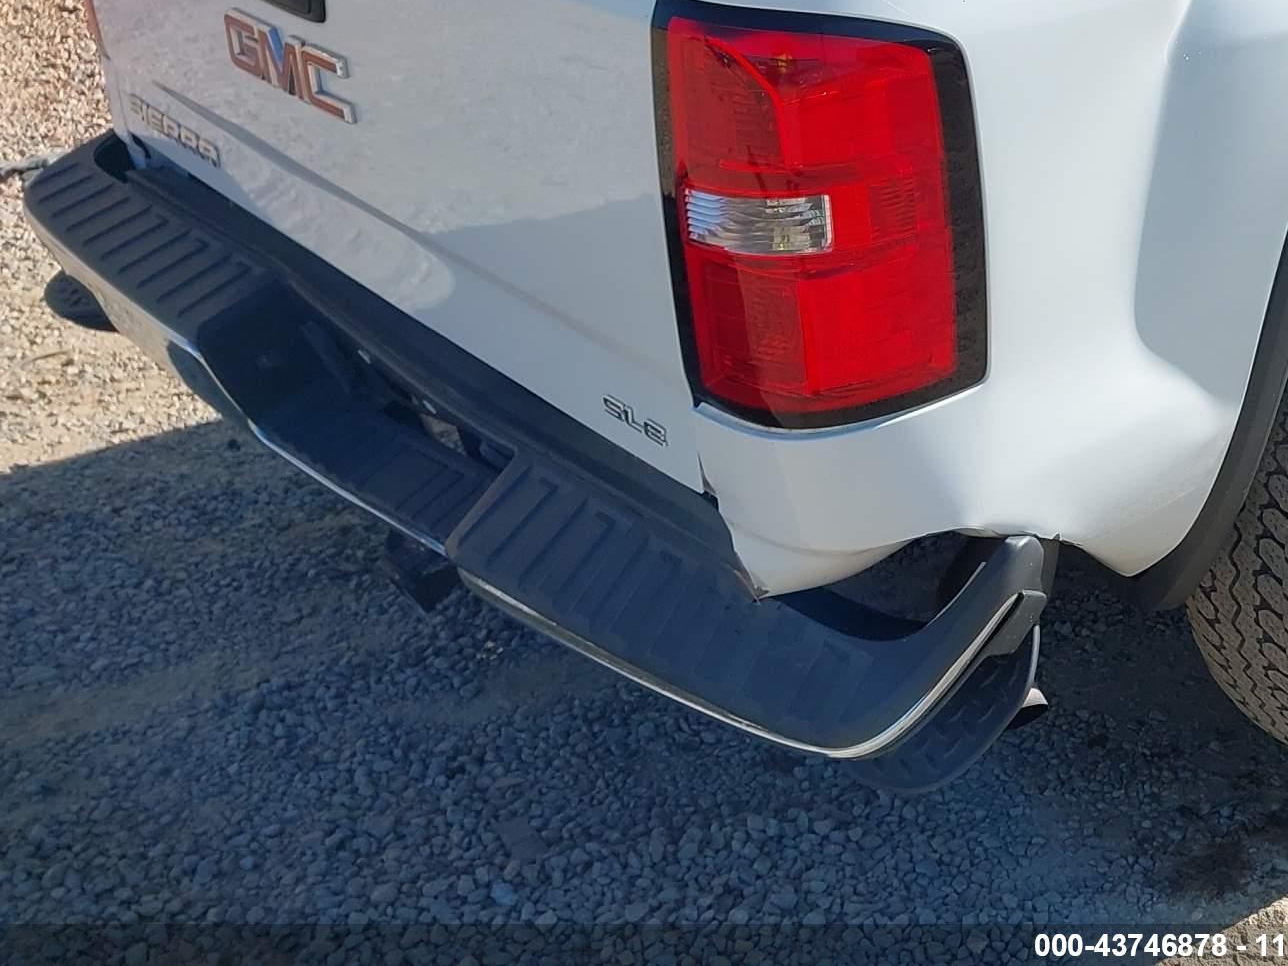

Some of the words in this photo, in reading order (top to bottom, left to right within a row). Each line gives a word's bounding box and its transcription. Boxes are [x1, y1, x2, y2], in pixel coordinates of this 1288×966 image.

[223, 7, 358, 125] GMC
[128, 92, 221, 170] SIERRA
[602, 393, 669, 448] SLE
